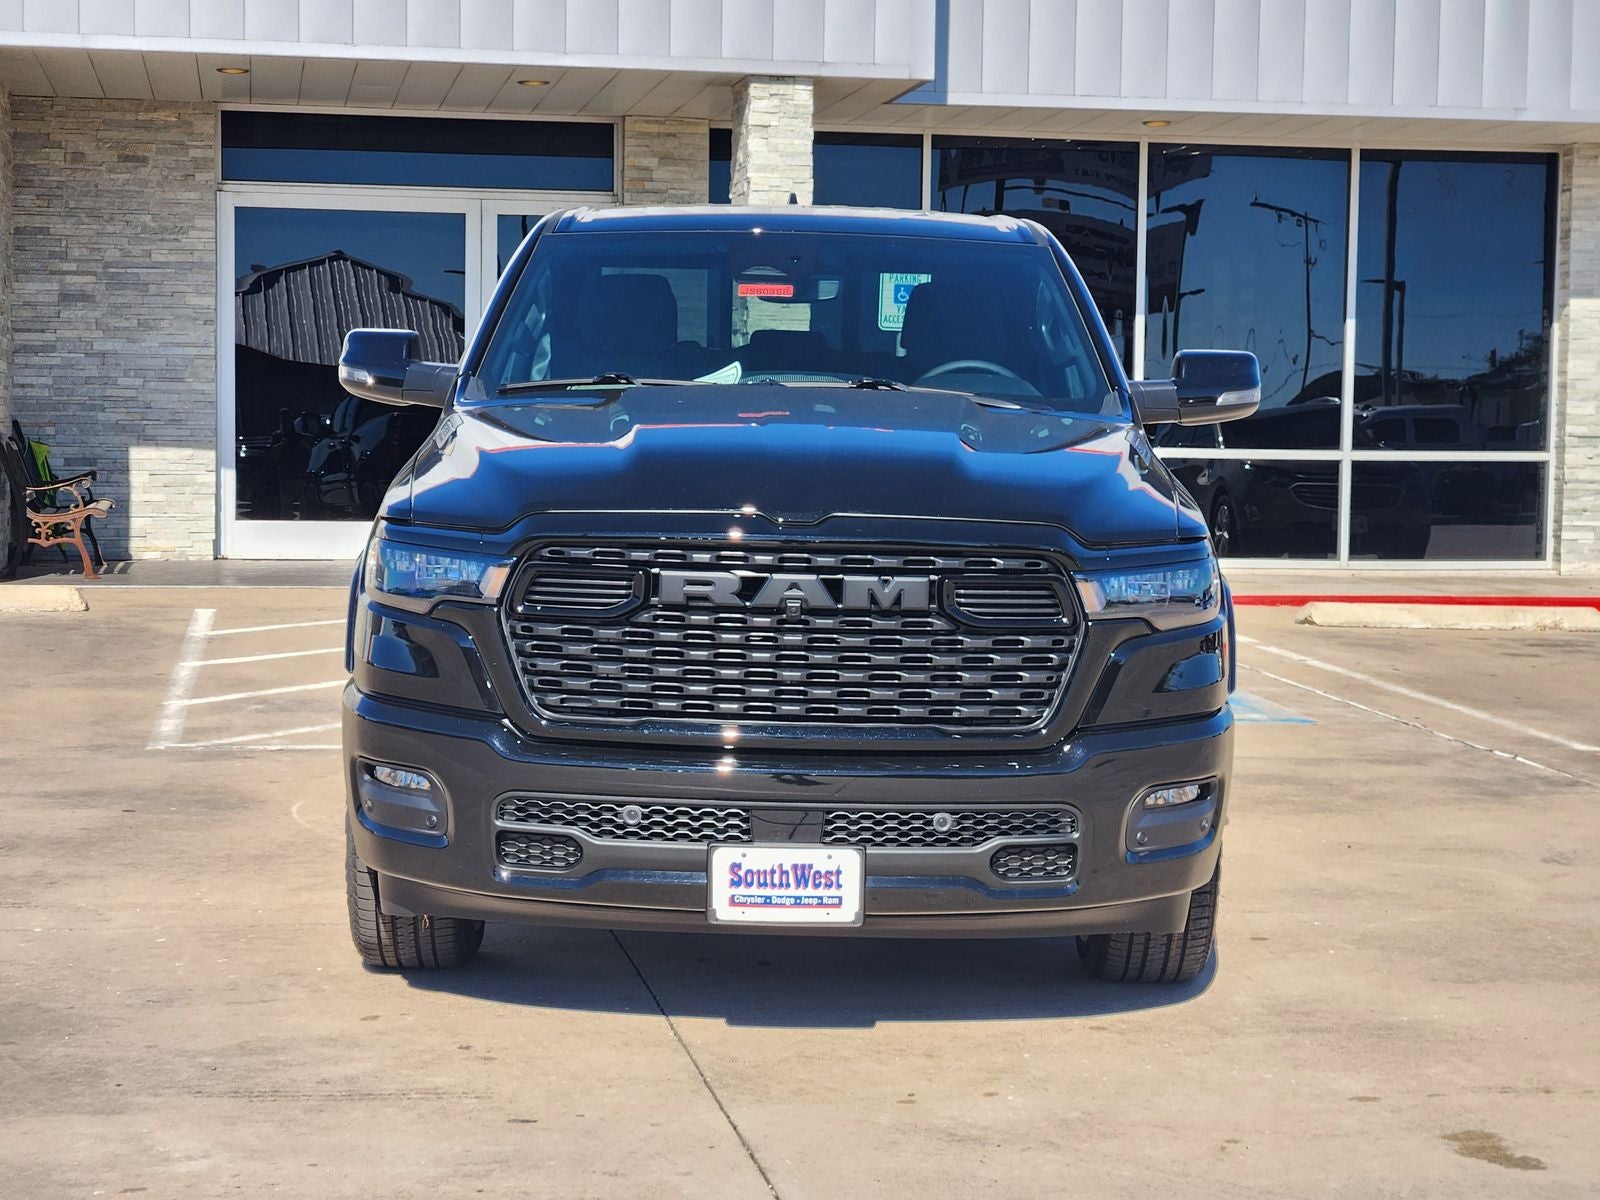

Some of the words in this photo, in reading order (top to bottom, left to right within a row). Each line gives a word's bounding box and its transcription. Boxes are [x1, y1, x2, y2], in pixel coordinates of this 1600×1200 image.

[889, 273, 922, 284] PARKING
[896, 304, 906, 314] VA
[659, 570, 931, 610] RAM
[728, 862, 843, 890] SouthWest
[734, 894, 765, 905] Chrysler
[771, 895, 795, 905] Dodge
[800, 896, 818, 906] Jeep
[822, 896, 839, 905] Ram
